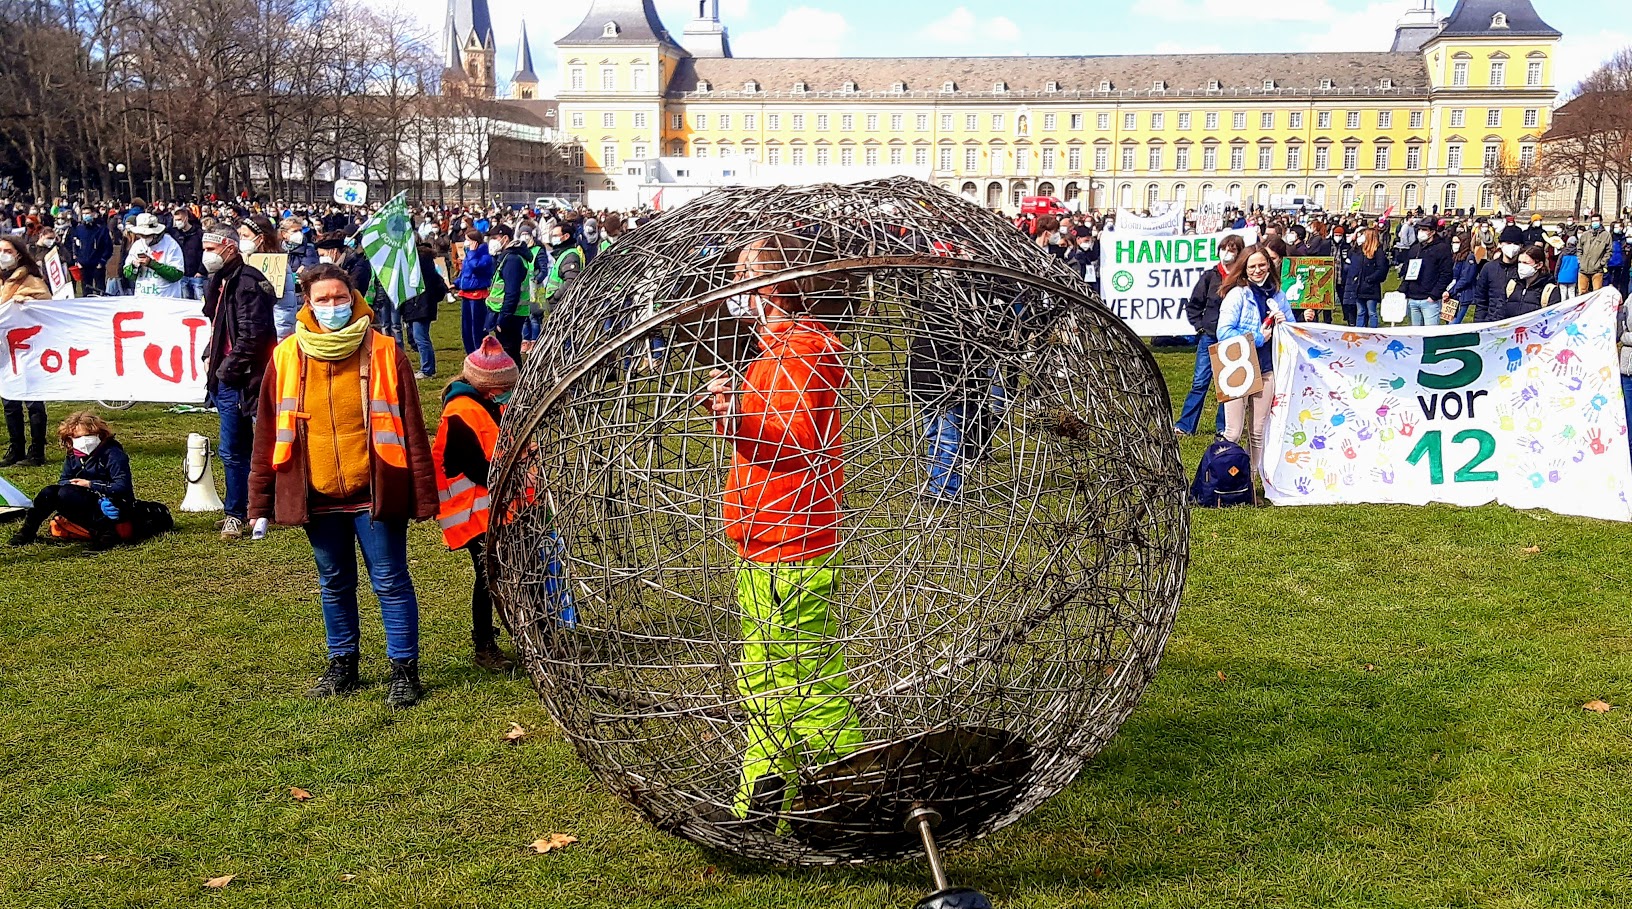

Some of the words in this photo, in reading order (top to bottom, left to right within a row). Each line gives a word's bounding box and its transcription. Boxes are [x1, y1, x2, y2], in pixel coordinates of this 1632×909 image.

[1199, 202, 1221, 215] KOHLE
[6, 325, 90, 376] For
[1217, 334, 1255, 398] 8
[1416, 333, 1485, 390] 5
[1417, 388, 1488, 421] vor
[1405, 429, 1499, 485] 12
